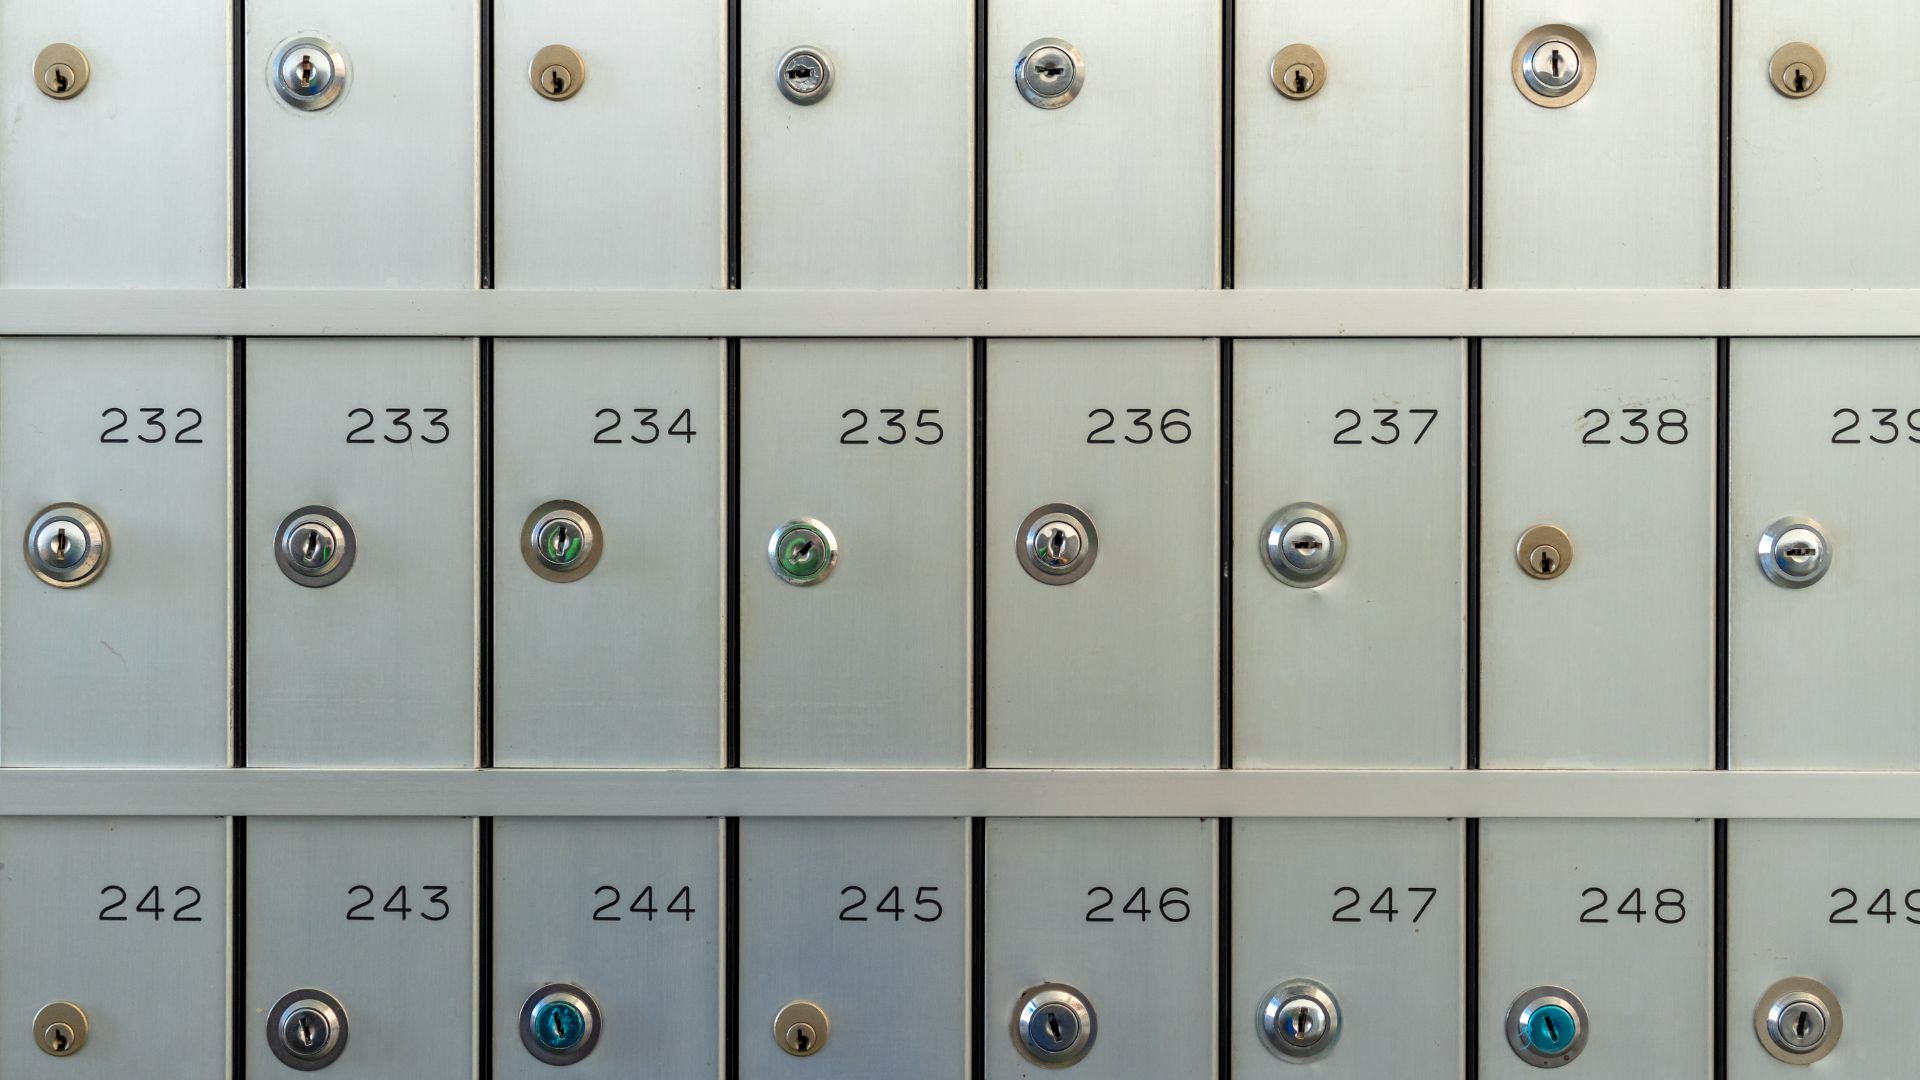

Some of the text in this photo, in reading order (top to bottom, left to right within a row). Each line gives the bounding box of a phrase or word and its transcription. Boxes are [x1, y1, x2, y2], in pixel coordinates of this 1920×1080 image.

[100, 407, 203, 444] 232
[346, 407, 450, 445] 233
[593, 408, 697, 445] 234
[839, 408, 944, 446] 235
[1086, 408, 1192, 445] 236
[1333, 408, 1439, 445] 237
[1581, 408, 1689, 445] 238
[98, 884, 203, 922] 242
[345, 884, 450, 922] 243
[592, 884, 696, 923] 244
[838, 885, 943, 923] 245
[1085, 886, 1191, 923] 246
[1331, 886, 1437, 924] 247
[1579, 886, 1686, 925] 248
